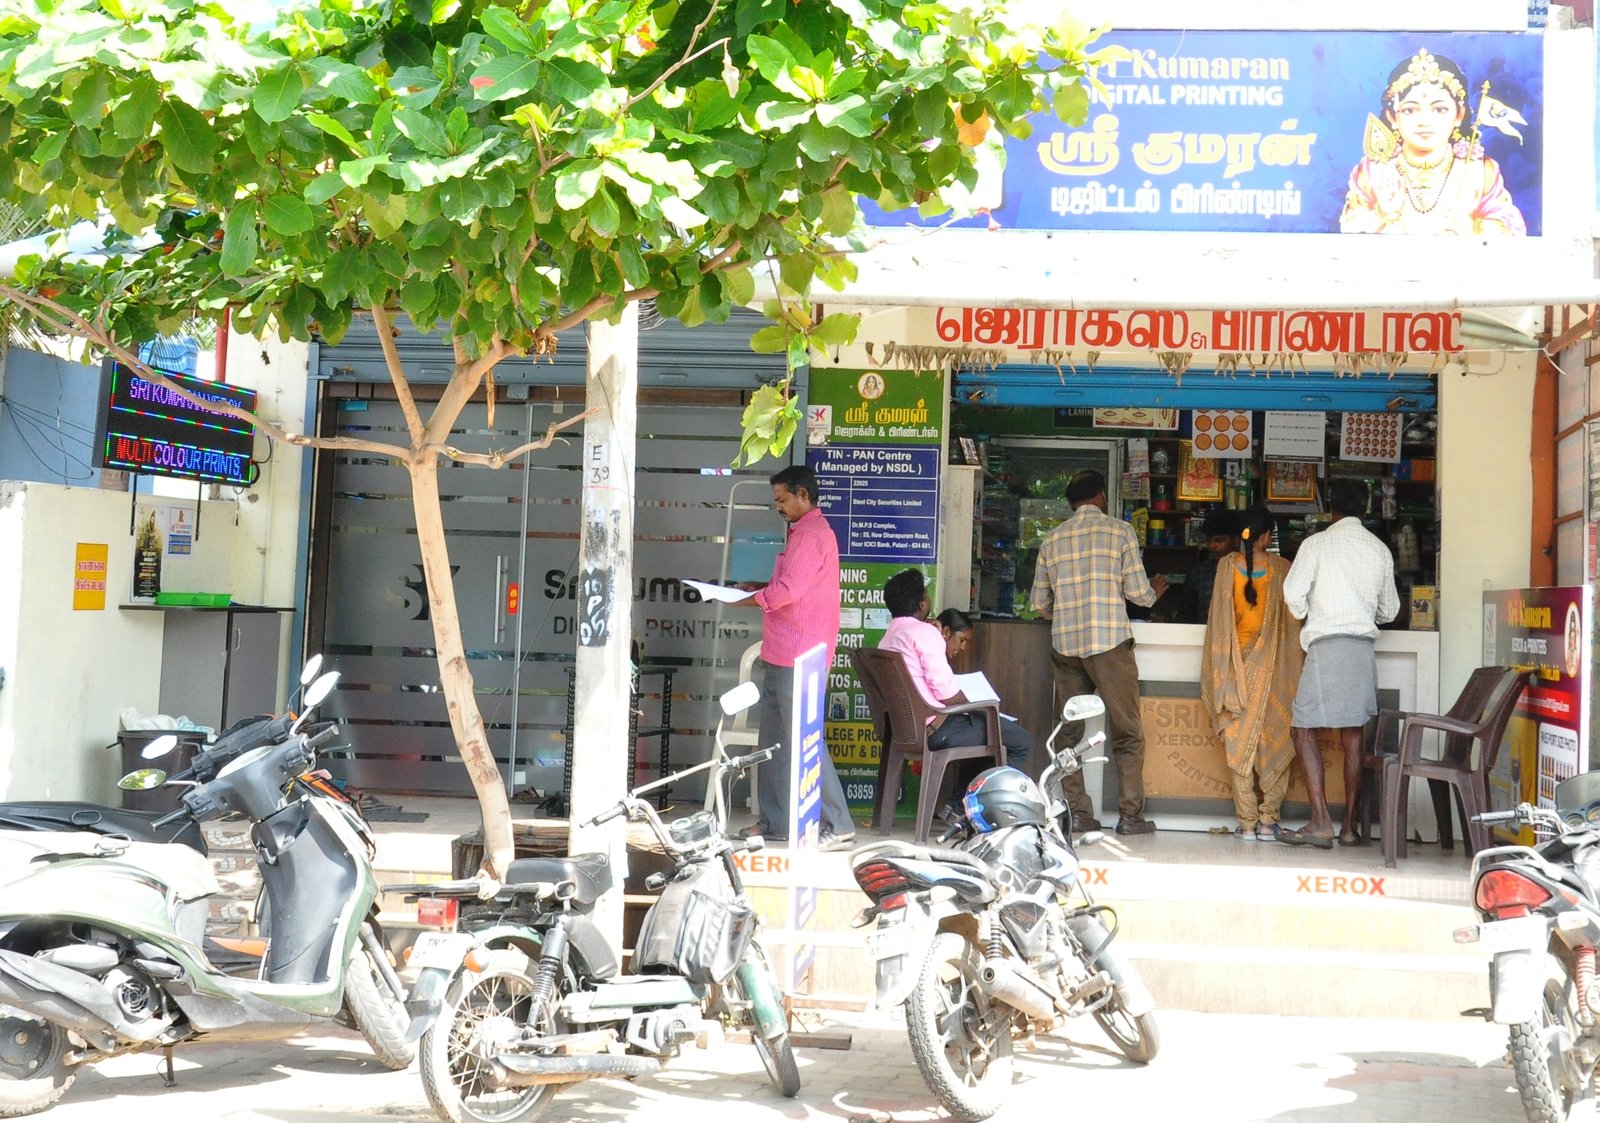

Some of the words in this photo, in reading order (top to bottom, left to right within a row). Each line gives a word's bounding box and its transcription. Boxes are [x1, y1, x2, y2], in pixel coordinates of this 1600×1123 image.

[1132, 48, 1290, 81] Kumaran
[1170, 85, 1284, 106] PRINTING
[1131, 118, 1317, 178] குமரன்
[1051, 180, 1160, 214] டிஜிட்டல்
[1170, 180, 1302, 218] பிரிண்டிங்
[130, 377, 150, 400] SRI
[875, 399, 929, 427] குமரன்
[835, 425, 876, 438] ஜெராக்ஸ்
[878, 427, 886, 437] &
[116, 438, 151, 463] MULTI
[153, 444, 203, 470] COLOUR
[203, 452, 243, 480] PRINTS,
[592, 445, 603, 461] E
[826, 450, 844, 460] TIN
[853, 450, 875, 460] PAN
[877, 451, 912, 461] Centre
[821, 462, 868, 474] Managed
[871, 463, 885, 475] by
[886, 464, 916, 474] NSDL
[866, 499, 877, 507] City
[883, 532, 914, 540] Dharapuram
[1156, 704, 1200, 728] SRI
[1156, 734, 1215, 748] XEROX
[859, 745, 867, 758] &
[1296, 876, 1385, 896] XEROX
